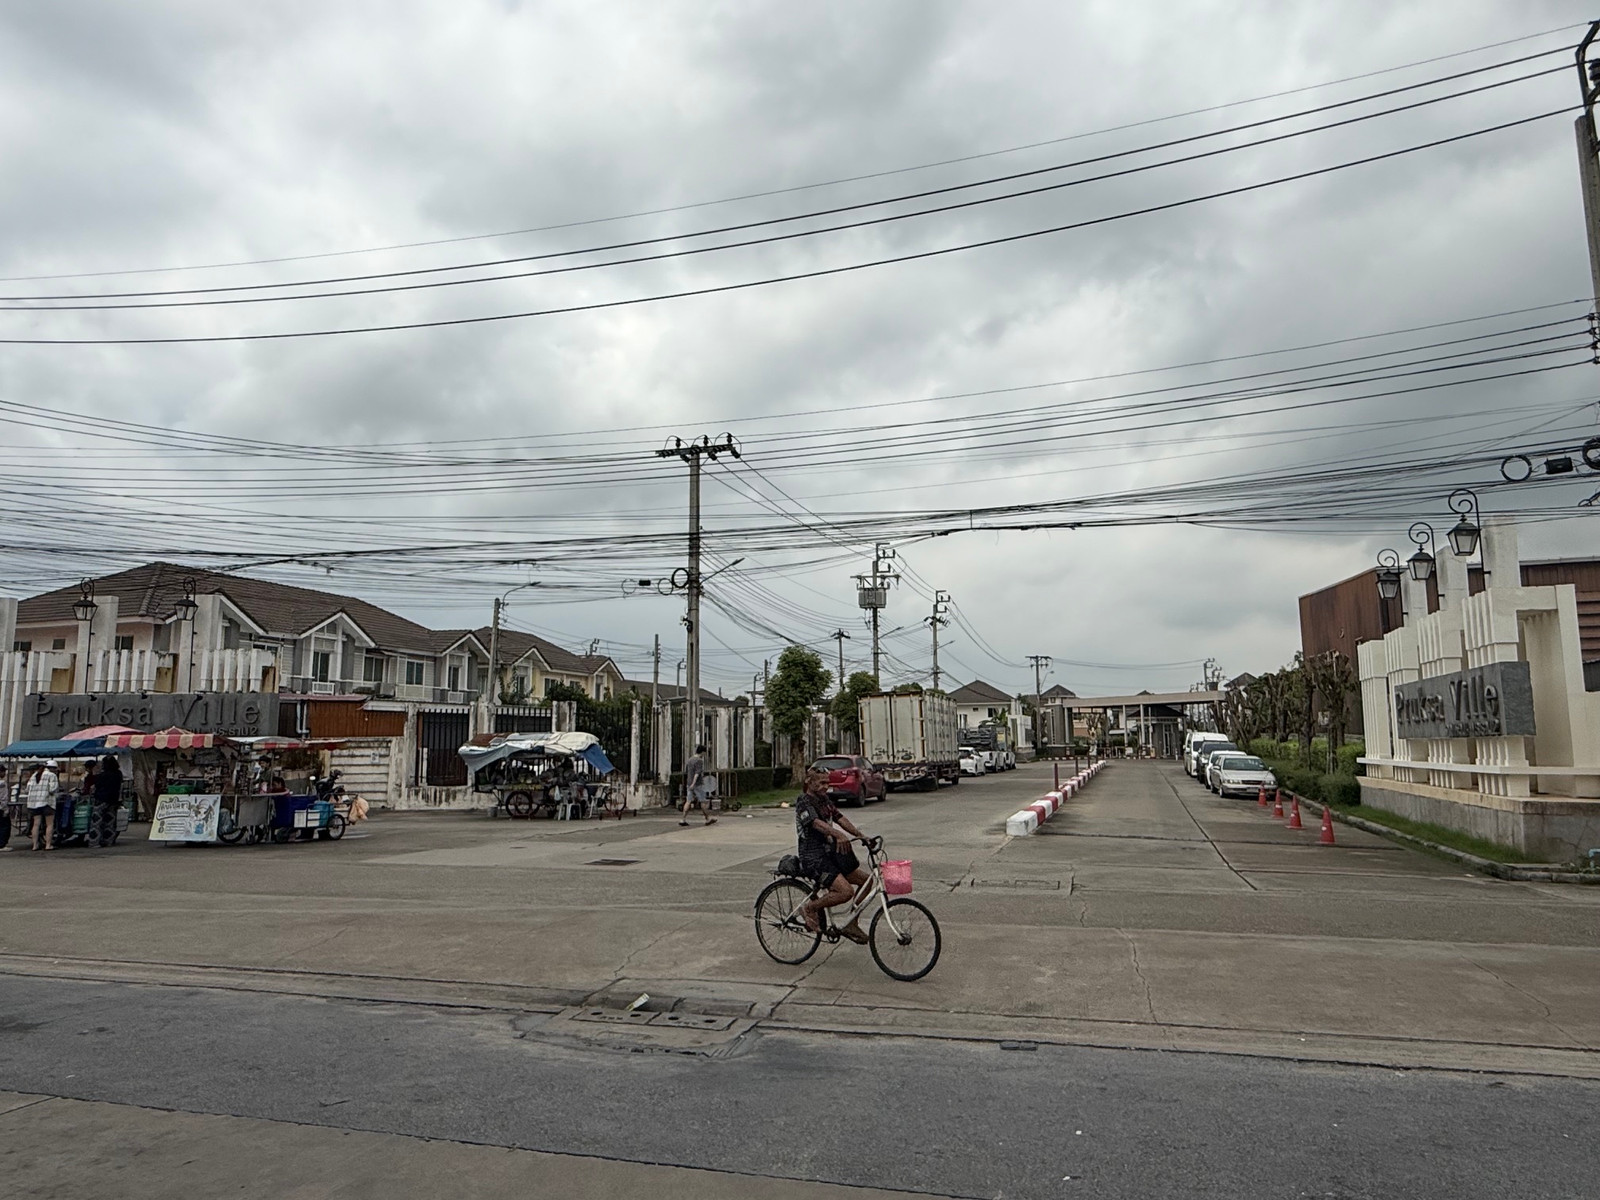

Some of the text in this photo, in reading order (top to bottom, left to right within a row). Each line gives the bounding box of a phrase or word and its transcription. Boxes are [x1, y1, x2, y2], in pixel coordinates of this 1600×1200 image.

[32, 699, 260, 727] Pruksa Ville
[1395, 675, 1499, 725] Pruksa Ville
